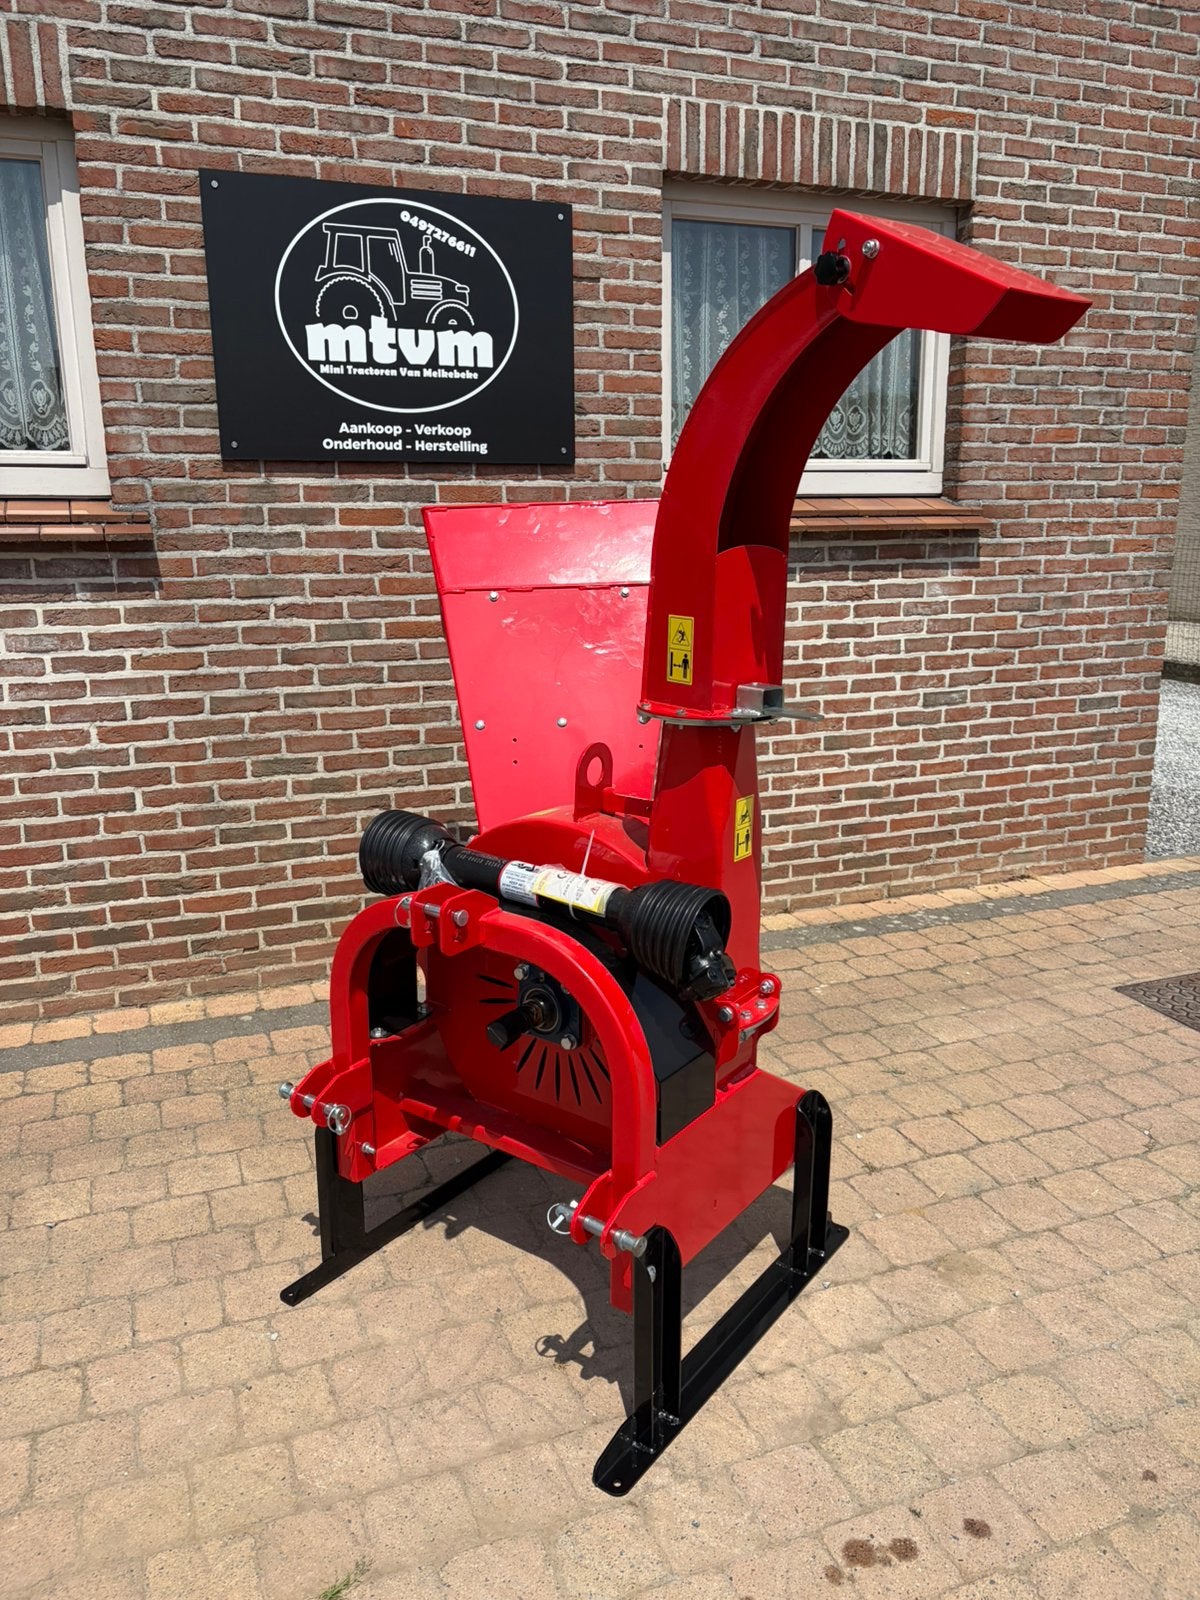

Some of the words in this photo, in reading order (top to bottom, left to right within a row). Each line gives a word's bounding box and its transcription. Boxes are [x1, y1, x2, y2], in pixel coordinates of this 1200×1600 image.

[400, 210, 477, 258] 0497276611
[305, 315, 494, 368] mtvm
[320, 364, 344, 375] Mini
[347, 366, 397, 377] Tractoren
[400, 368, 421, 377] Van
[423, 370, 479, 380] Melkebeke
[339, 422, 403, 437] Aankoop
[414, 424, 472, 439] Verkoop
[322, 438, 403, 451] Onderhoud
[414, 440, 488, 455] Herstelling
